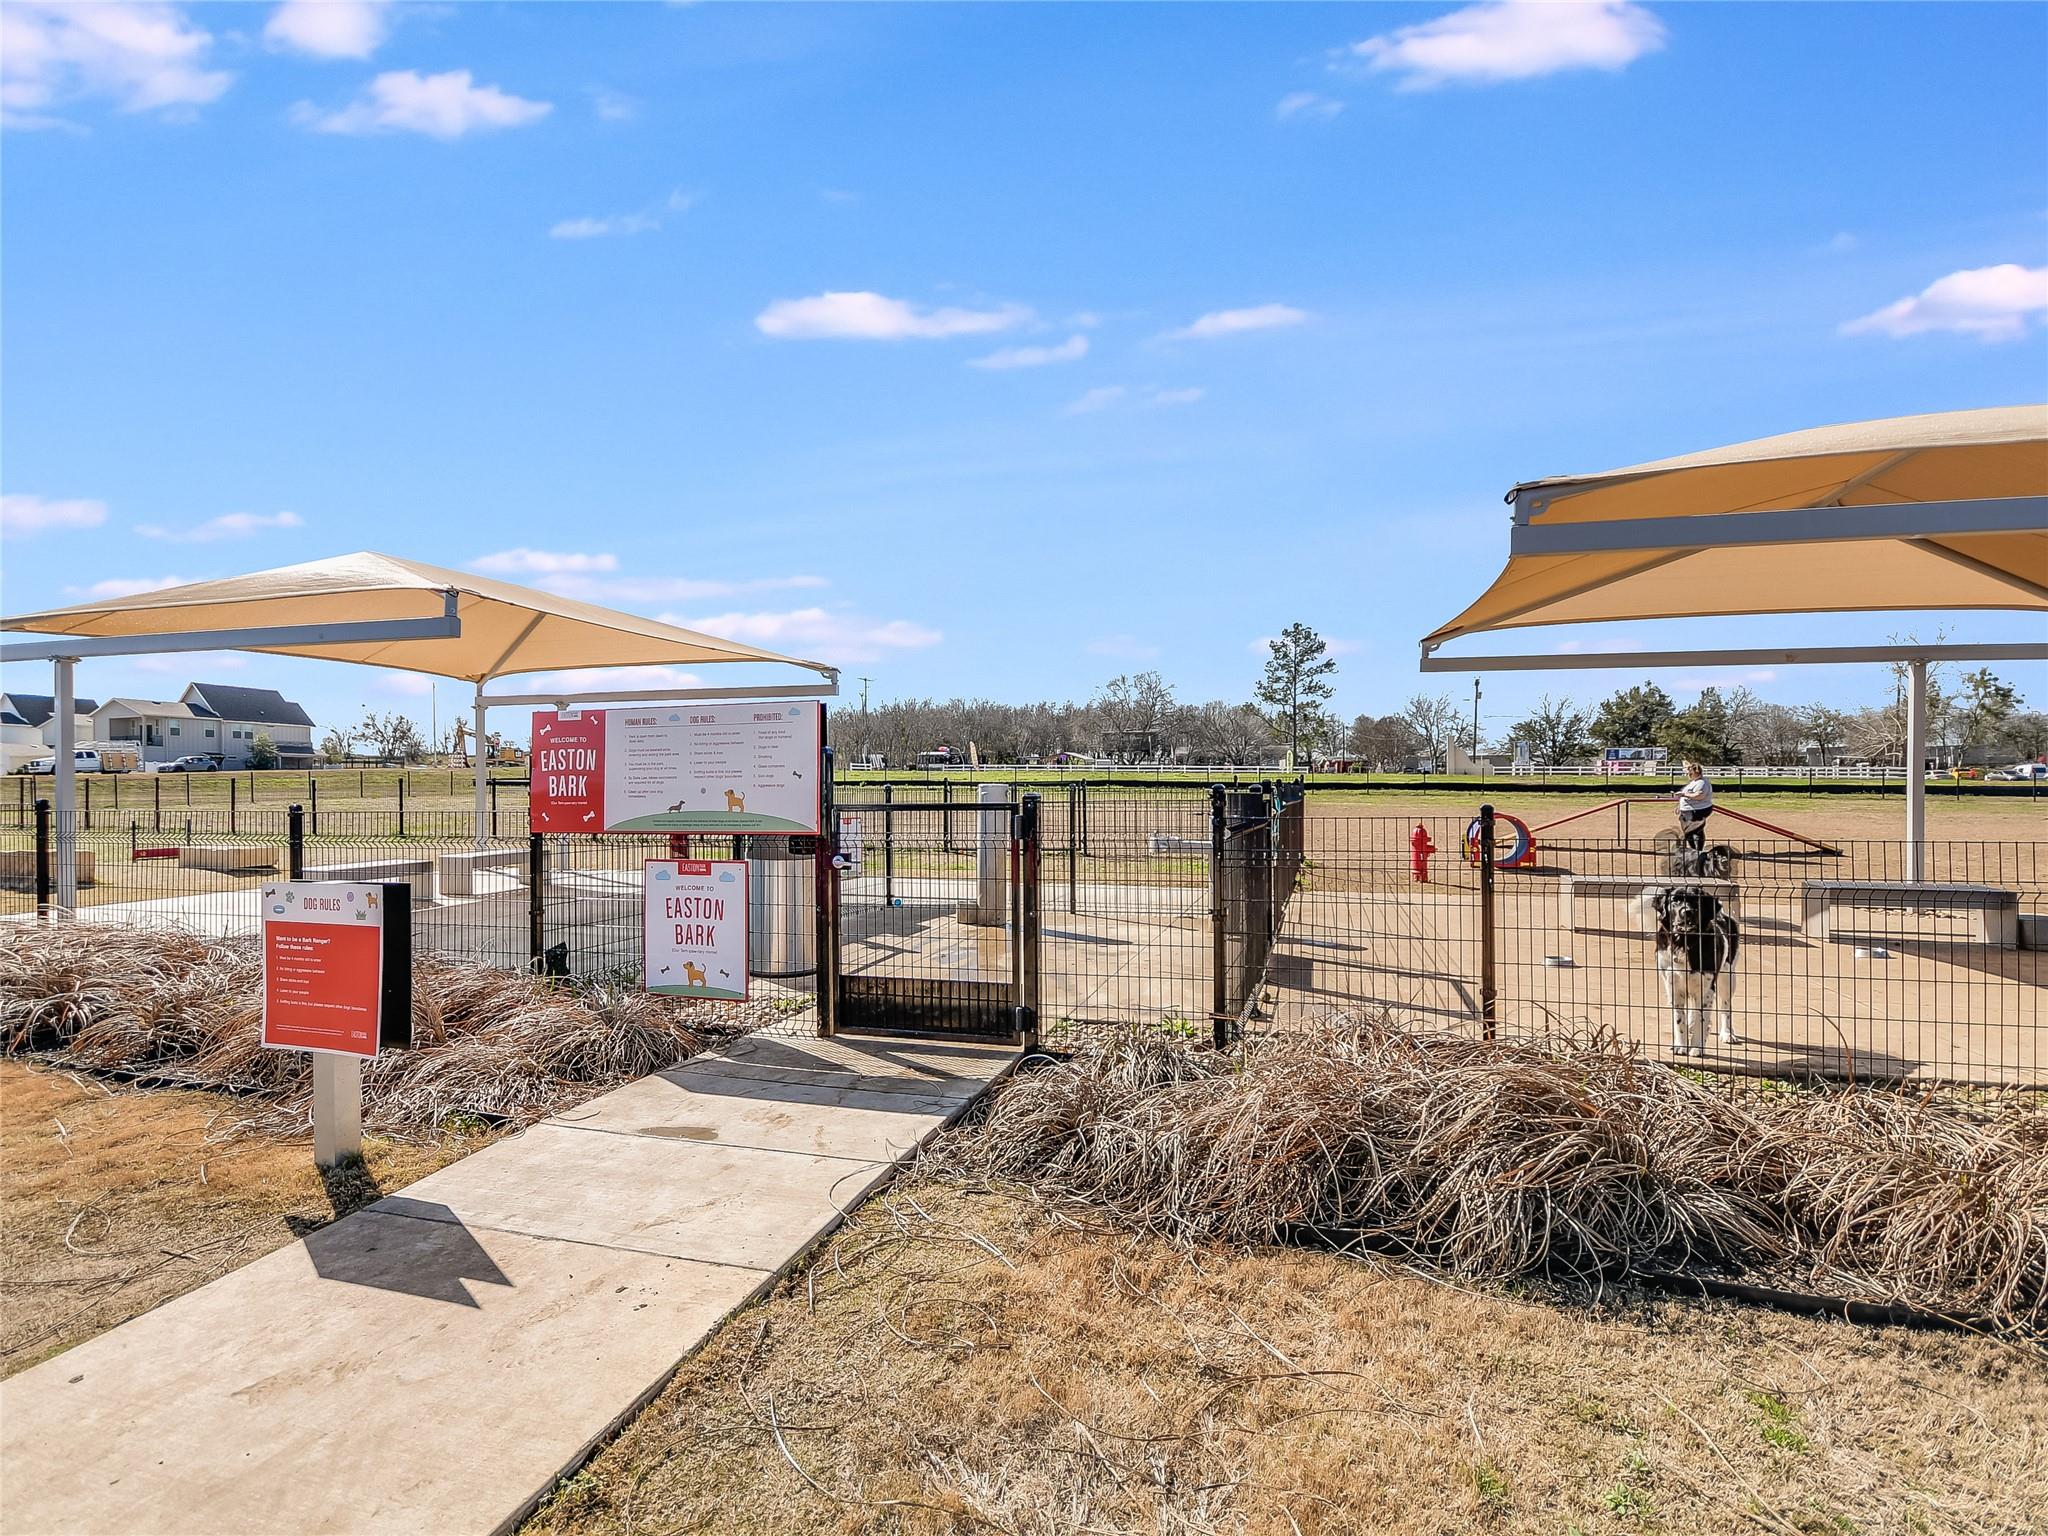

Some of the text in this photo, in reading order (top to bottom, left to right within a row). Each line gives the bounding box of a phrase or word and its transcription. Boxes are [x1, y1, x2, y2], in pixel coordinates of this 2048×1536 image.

[624, 717, 658, 726] HUMAN RULES:
[690, 715, 716, 724] DOG RULES:
[753, 712, 783, 721] PROHIBITED:
[541, 749, 596, 772] EASTON
[549, 775, 588, 797] BARK
[682, 863, 700, 872] EASTON
[303, 897, 341, 911] DOG RULES
[666, 897, 724, 921] EASTON
[675, 924, 716, 947] BARK
